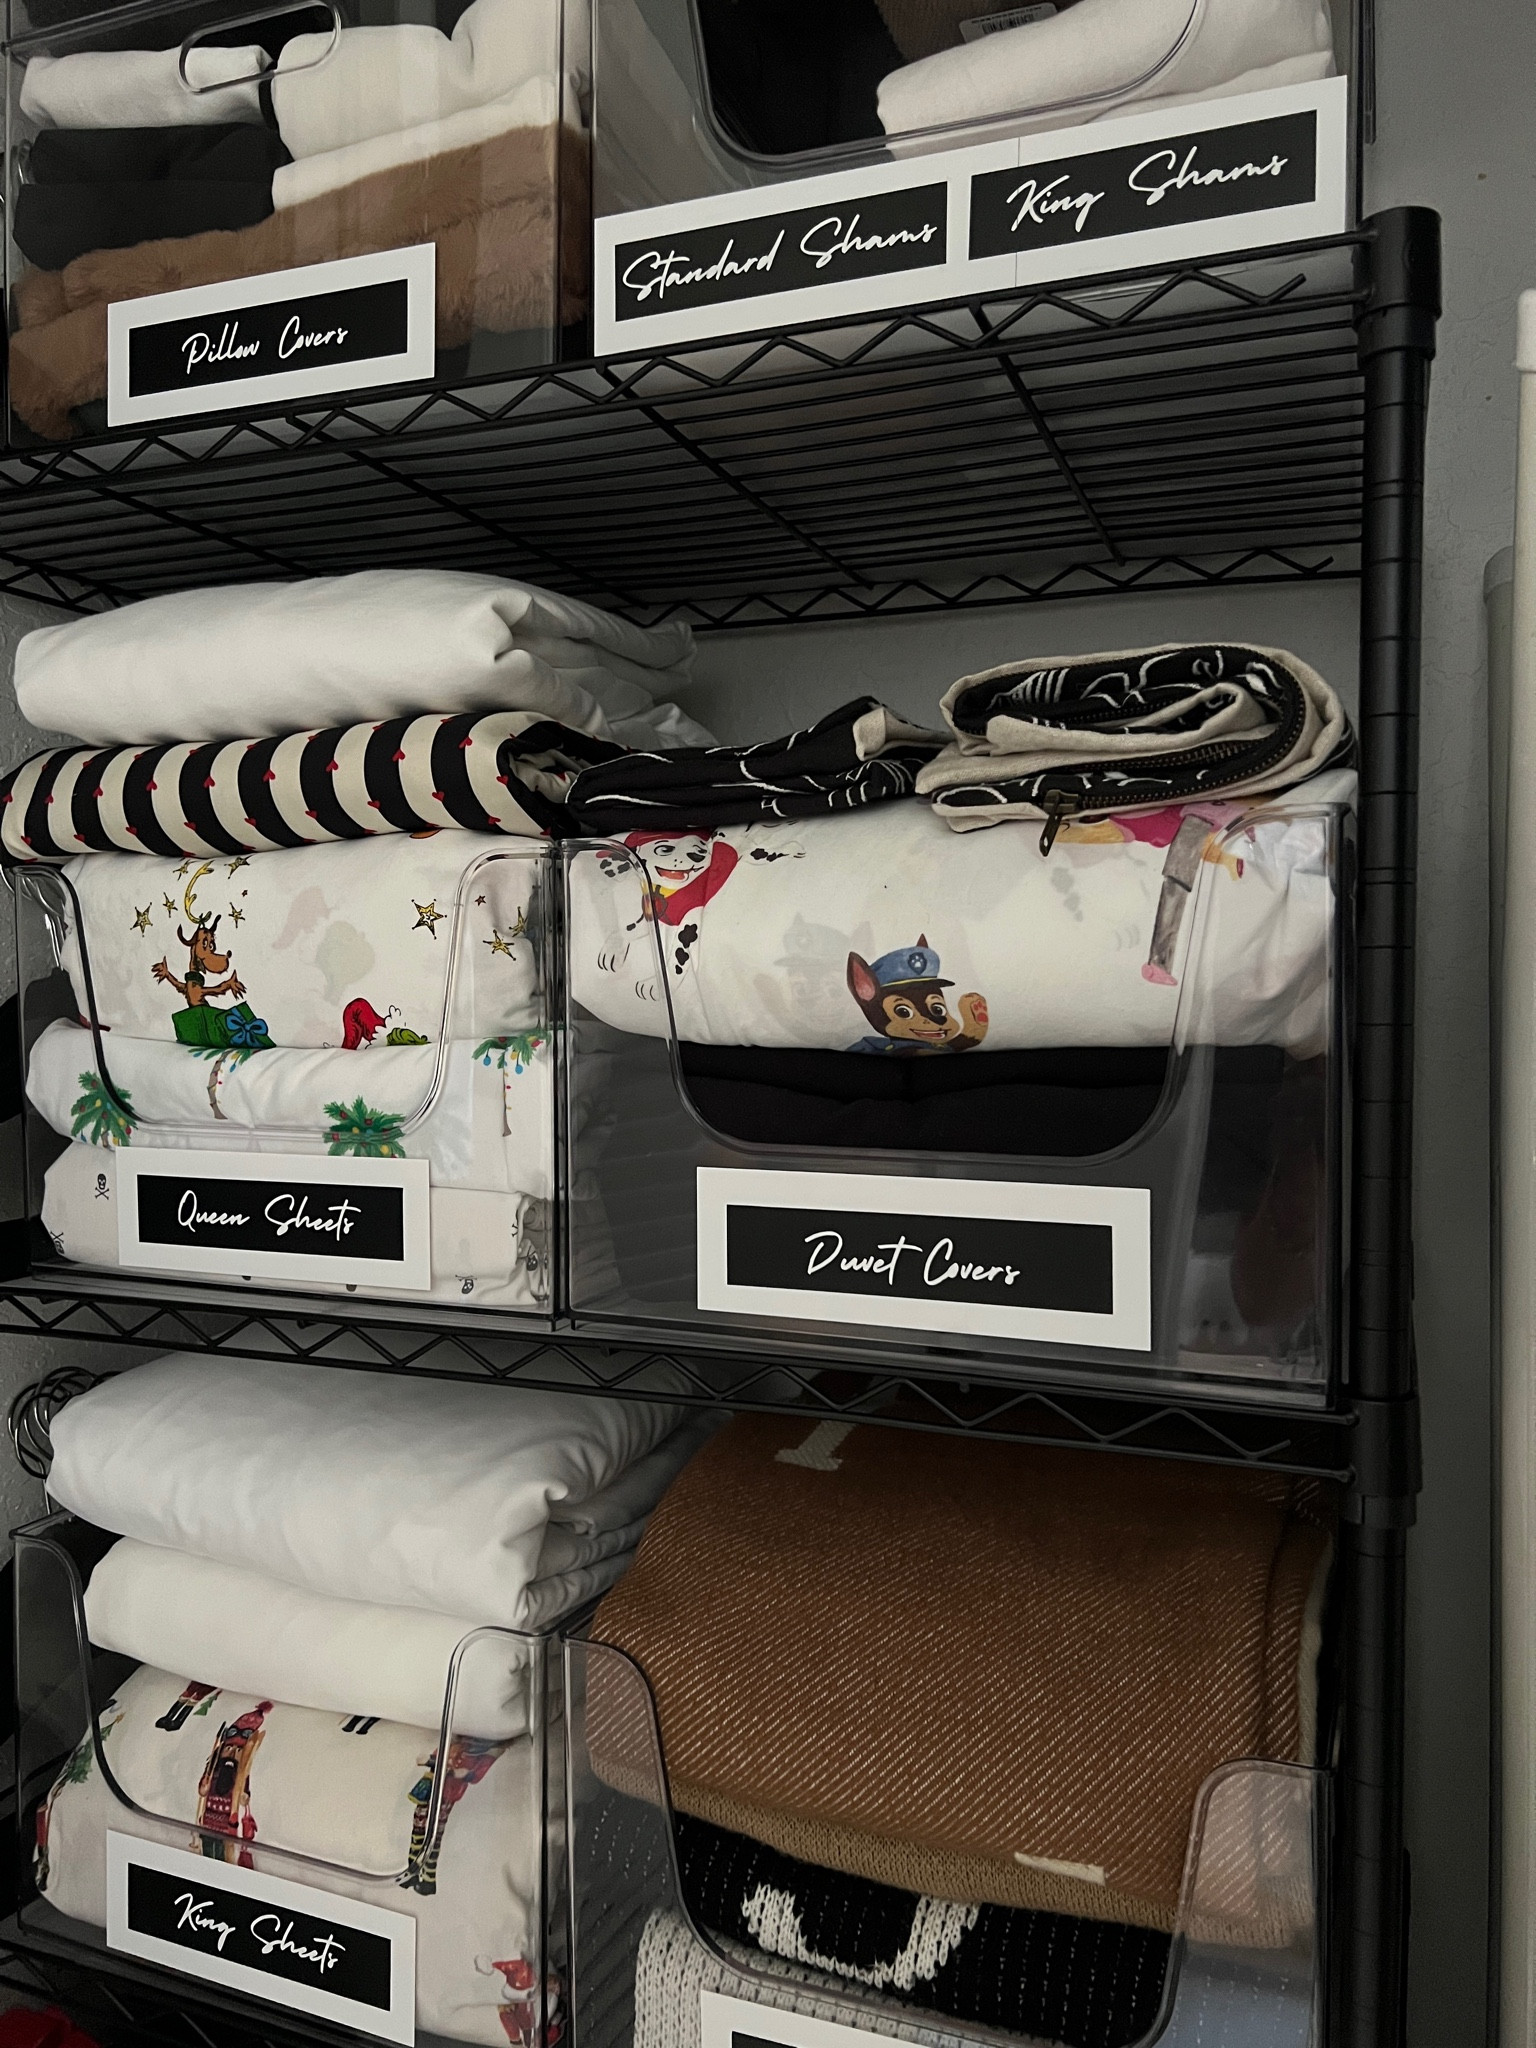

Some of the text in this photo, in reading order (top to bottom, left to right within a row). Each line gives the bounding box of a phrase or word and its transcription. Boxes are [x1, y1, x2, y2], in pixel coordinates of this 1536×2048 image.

[1005, 145, 1288, 233] King Shams
[622, 213, 938, 303] Standard Shams
[181, 315, 349, 375] Pillow Covers
[177, 1189, 362, 1242] Queen Sheets
[804, 1230, 1021, 1286] Duvet Covers
[173, 1892, 346, 1974] King Sheets
